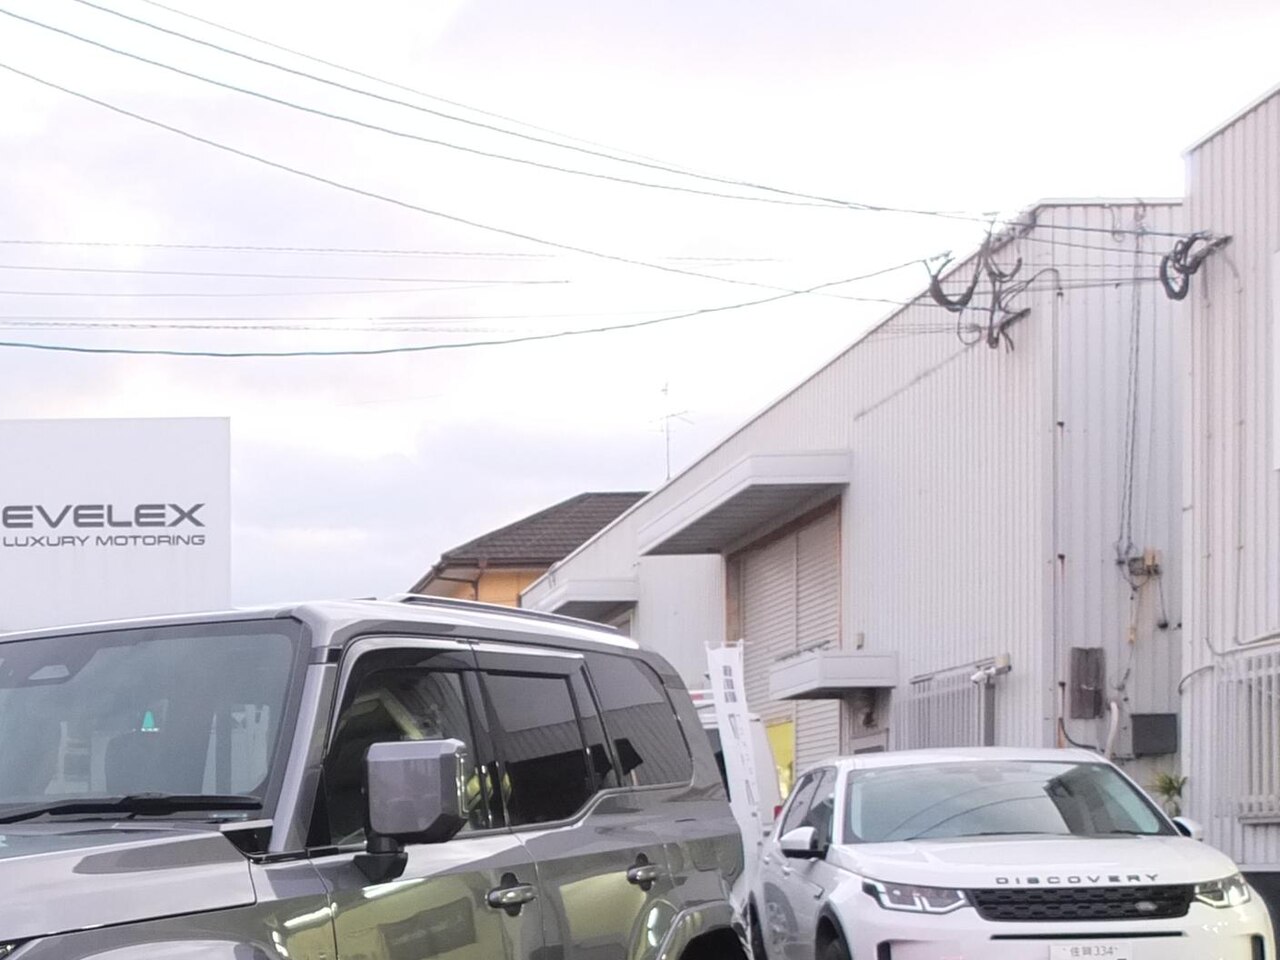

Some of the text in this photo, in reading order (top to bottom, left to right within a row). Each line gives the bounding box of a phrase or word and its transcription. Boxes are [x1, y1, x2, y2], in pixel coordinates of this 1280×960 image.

[2, 503, 205, 528] EVELEX
[3, 534, 205, 547] LUXURY MOTORING
[995, 874, 1158, 885] DISCOVERY
